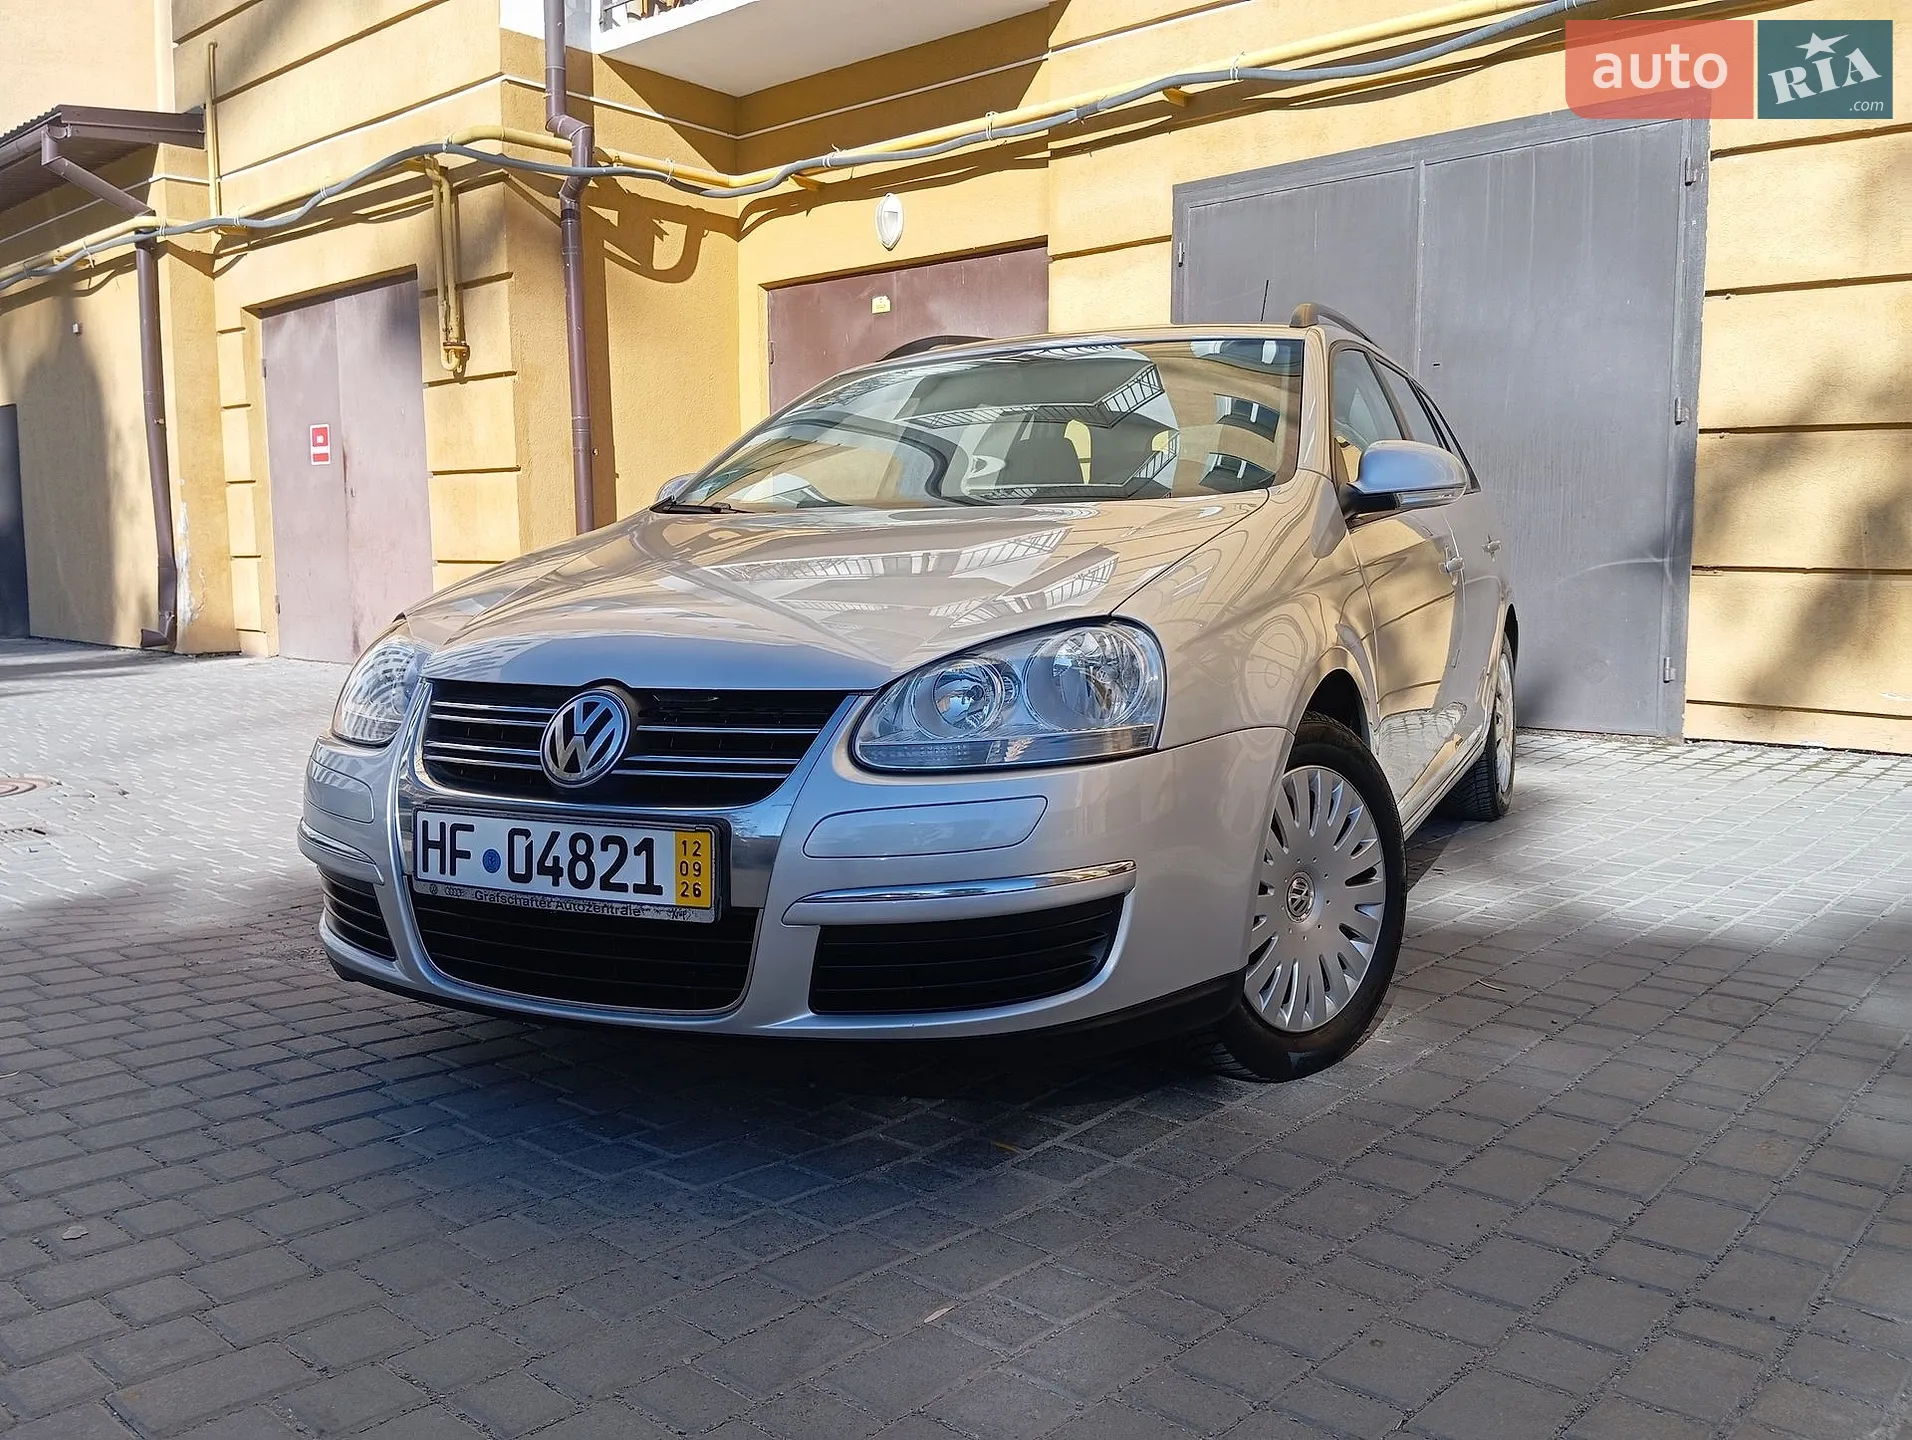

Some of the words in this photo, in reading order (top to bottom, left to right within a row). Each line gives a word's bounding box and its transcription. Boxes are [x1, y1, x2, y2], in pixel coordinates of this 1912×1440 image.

[543, 692, 627, 785] VW
[681, 839, 702, 857] 12
[421, 819, 475, 876] HF
[507, 827, 664, 896] 04821
[680, 860, 702, 877] 09
[680, 881, 702, 898] 26
